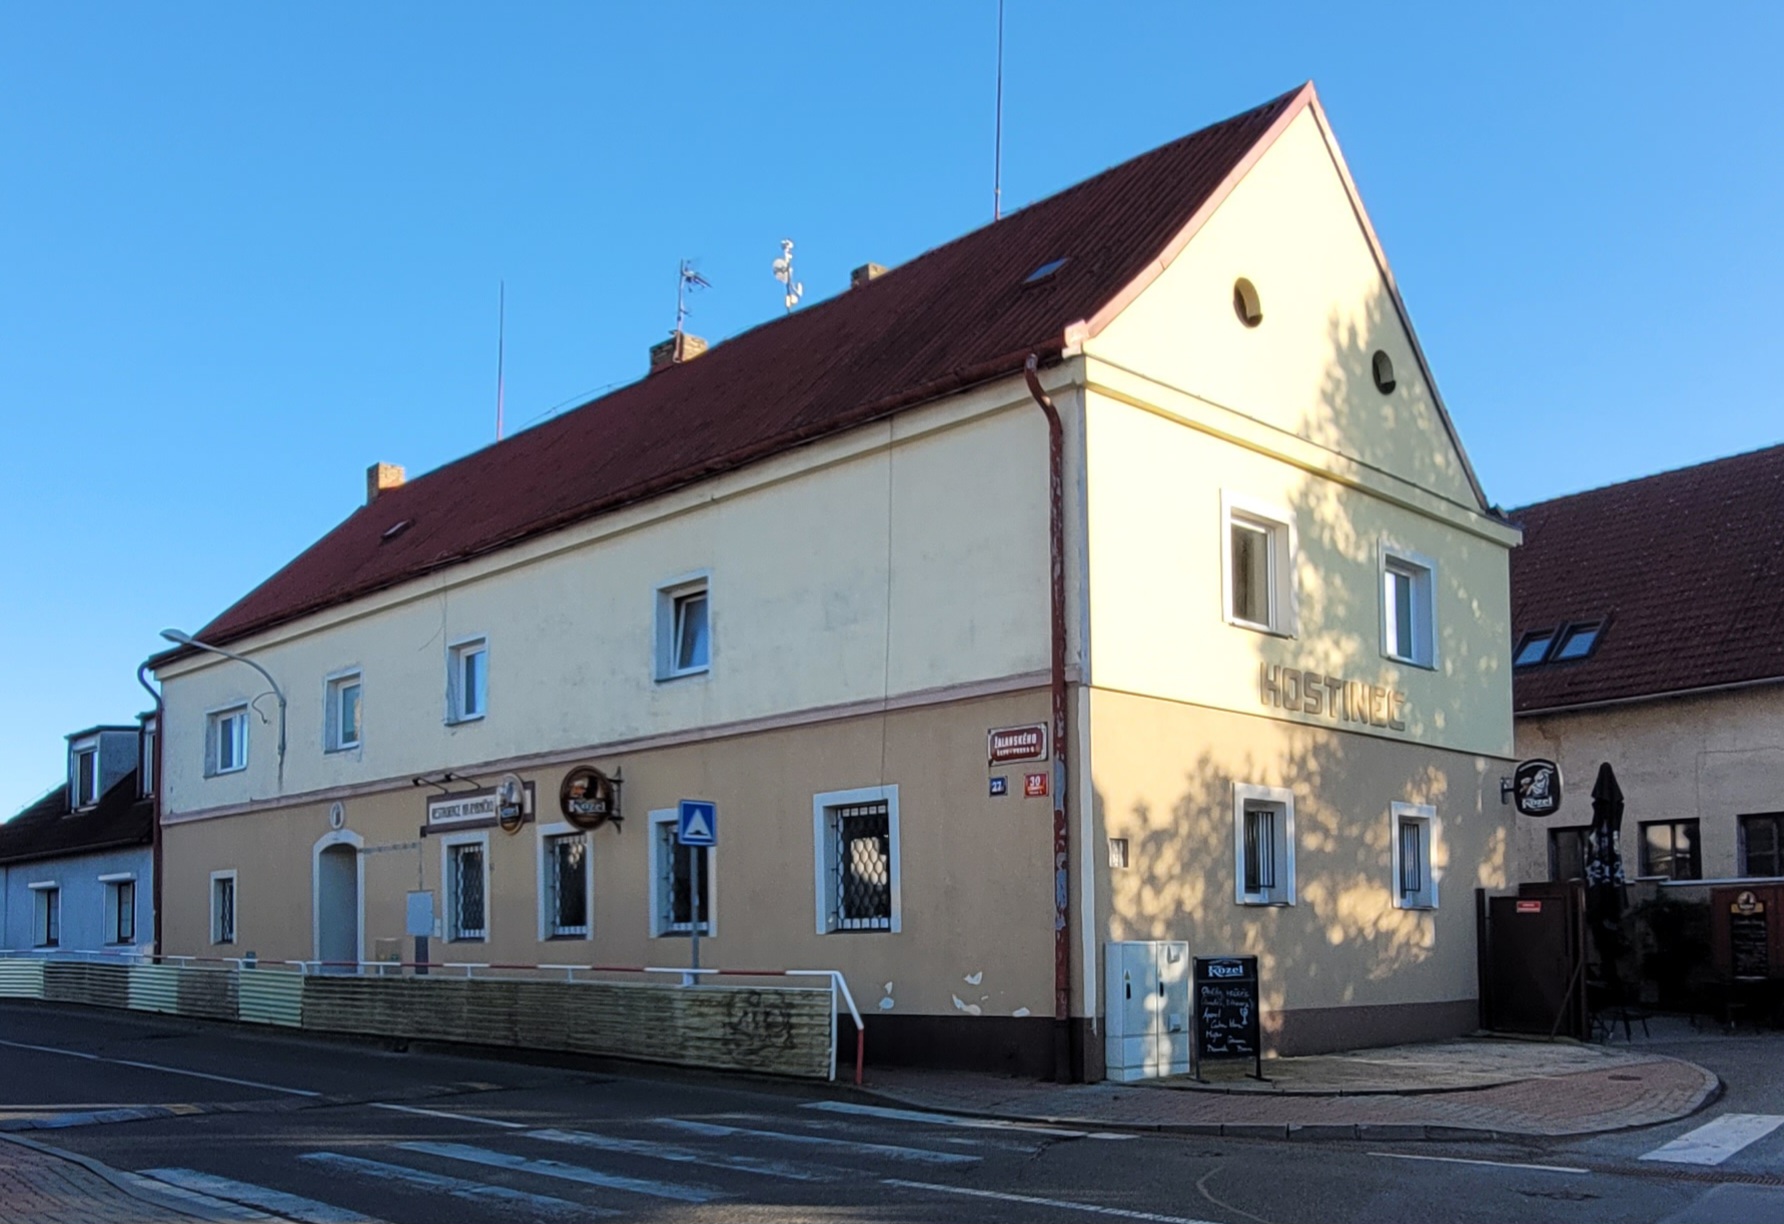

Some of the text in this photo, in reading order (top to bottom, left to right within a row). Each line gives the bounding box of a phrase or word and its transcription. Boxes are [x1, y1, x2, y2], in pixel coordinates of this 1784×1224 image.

[1260, 662, 1406, 731] HOSTINEC
[1522, 796, 1553, 809] Kozel
[1208, 965, 1243, 977] Kozel
